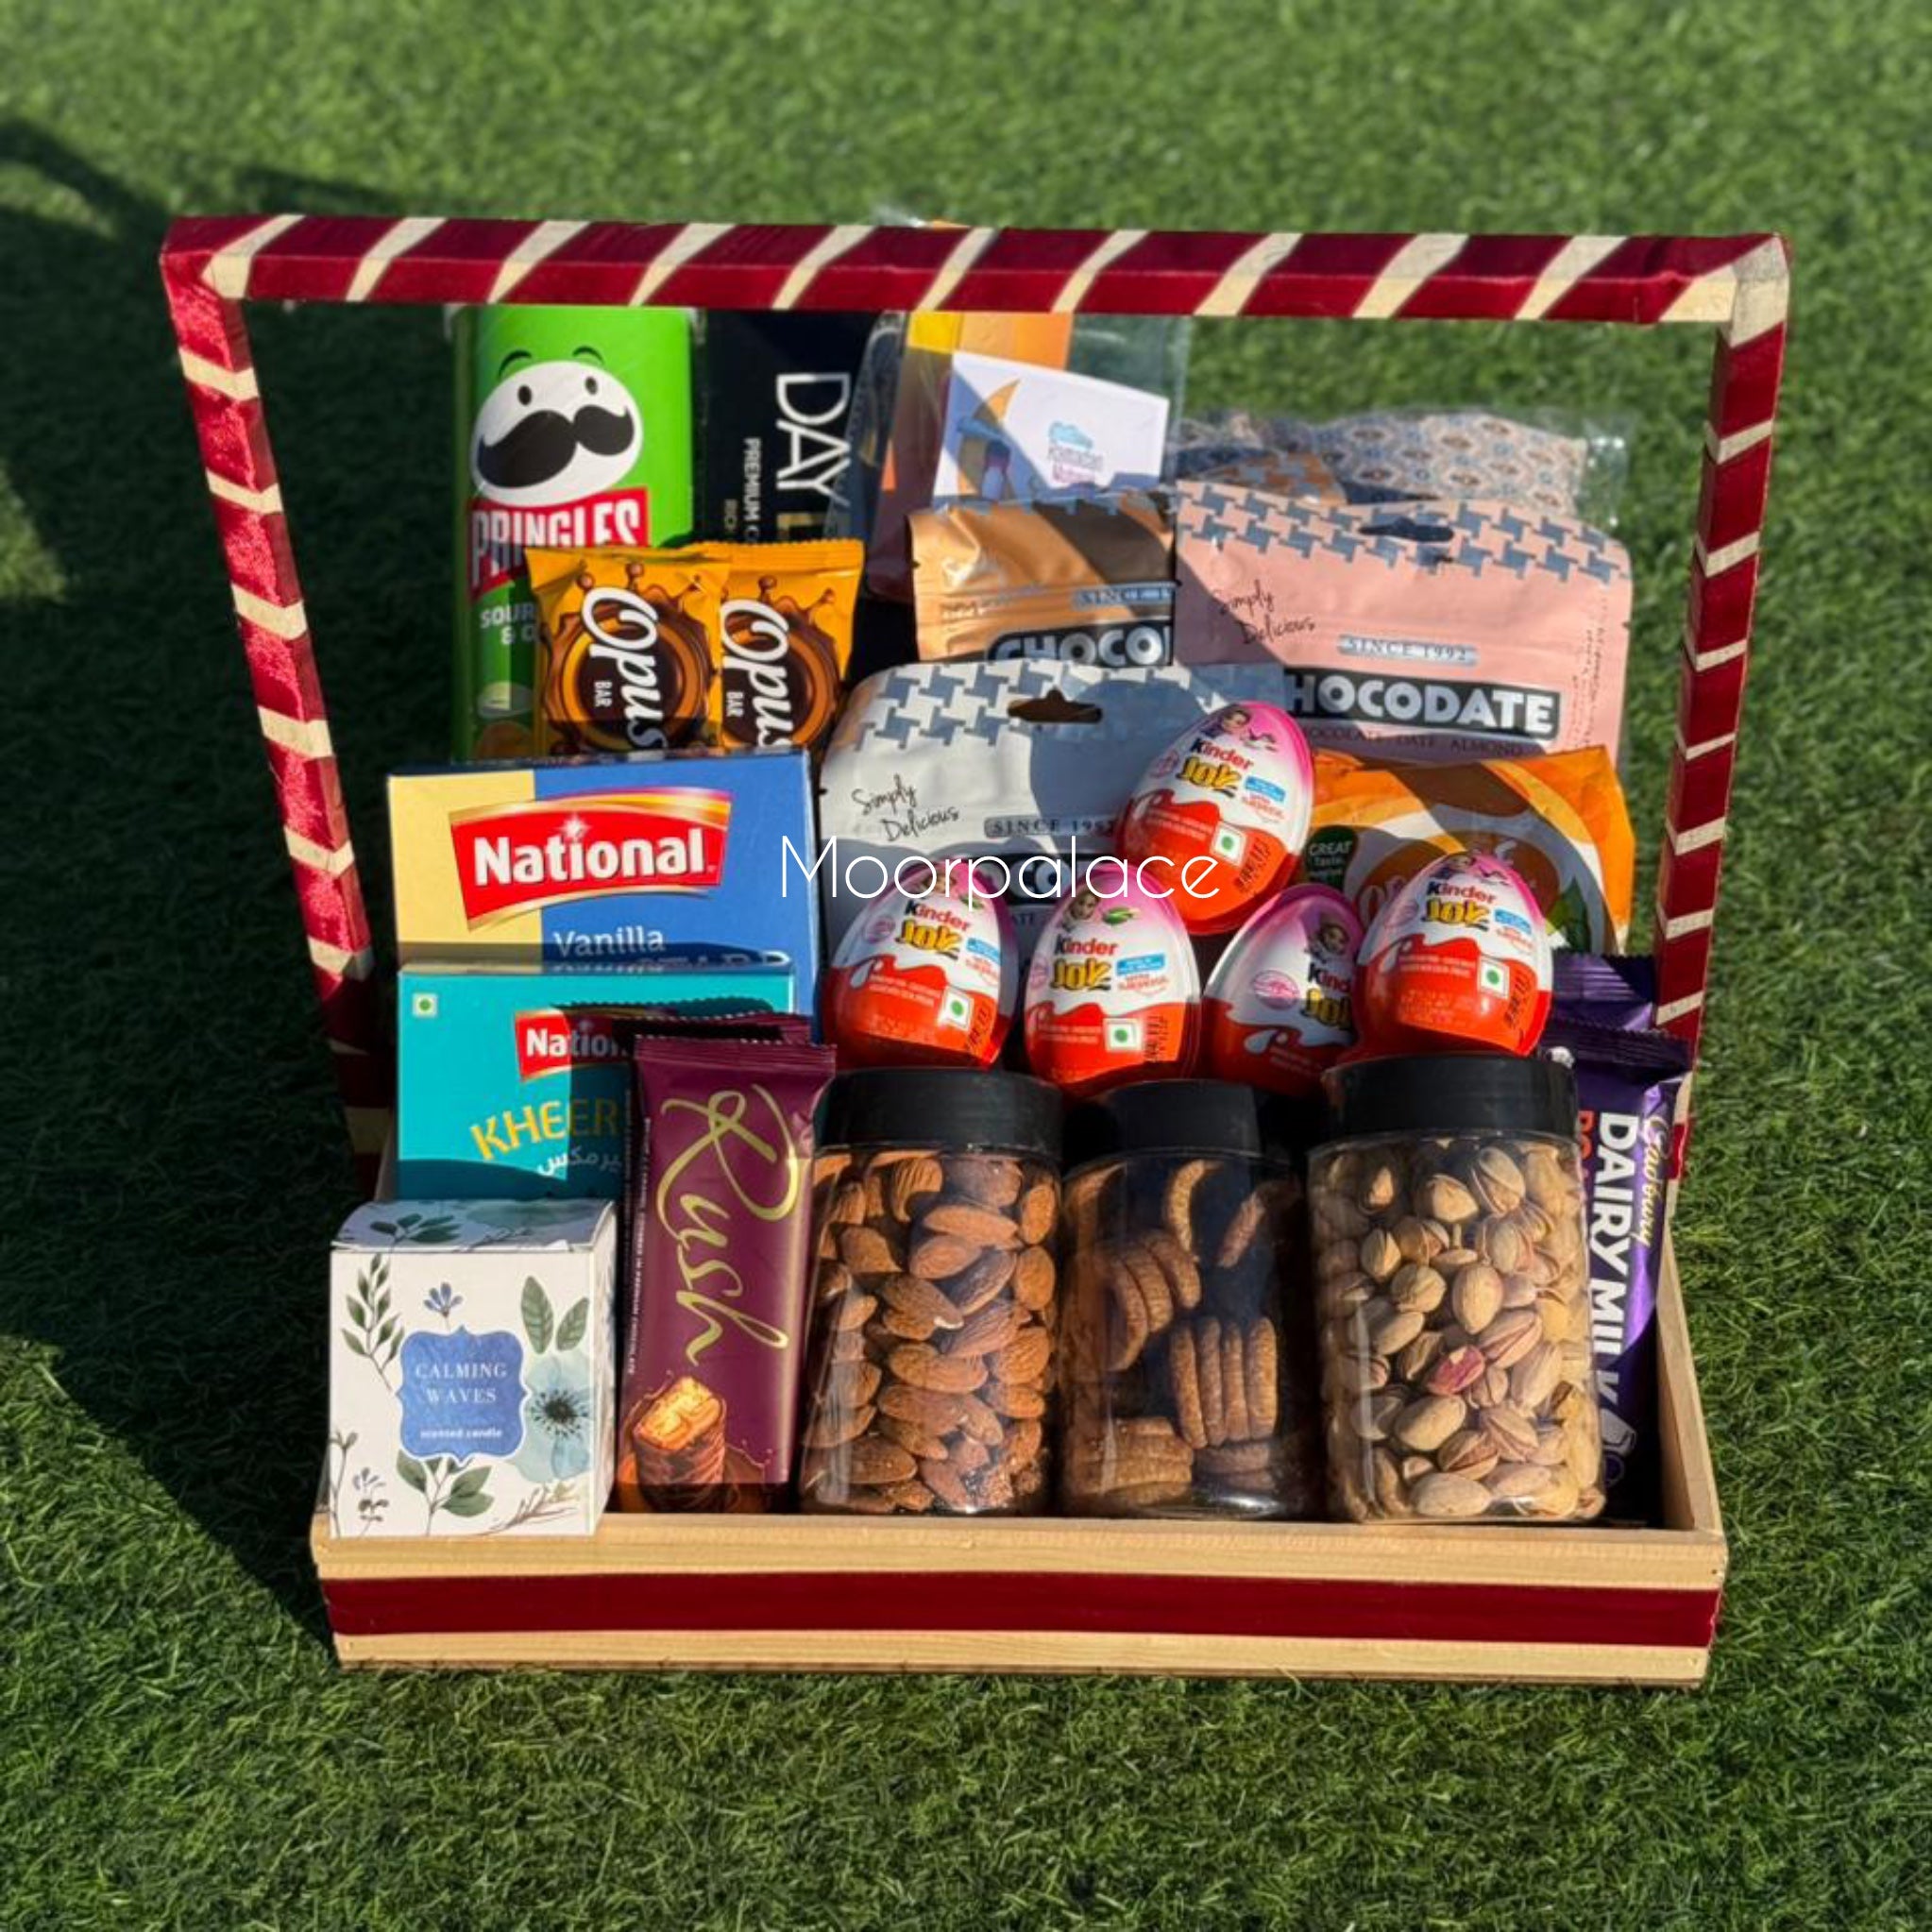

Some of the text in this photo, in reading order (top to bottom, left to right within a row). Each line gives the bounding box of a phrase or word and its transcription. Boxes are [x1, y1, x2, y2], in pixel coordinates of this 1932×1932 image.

[776, 372, 852, 508] DAY
[743, 437, 761, 522] PREMIUM
[480, 602, 536, 629] SOUR
[1347, 637, 1419, 658] SINCE
[581, 586, 669, 749] Opus
[594, 681, 613, 708] BAR
[726, 691, 744, 718] BAR
[1286, 672, 1554, 735] HOCODATE
[1190, 737, 1254, 771] Kinder
[851, 773, 918, 816] Simply
[881, 805, 960, 842] Delicious
[992, 818, 1060, 835] SINCE
[474, 827, 705, 887] National
[1310, 840, 1351, 856] GREAT
[1426, 881, 1499, 905] Kinder
[905, 899, 971, 932] Kinder
[552, 925, 667, 958] Vanilla
[1055, 934, 1118, 956] Kinder
[469, 1099, 618, 1161] KHEER
[1589, 1111, 1640, 1276] DAIRY
[1628, 1114, 1672, 1248] Cadbury
[656, 1083, 800, 1366] Rush
[415, 1362, 508, 1380] CALMING
[426, 1386, 497, 1404] WAVES
